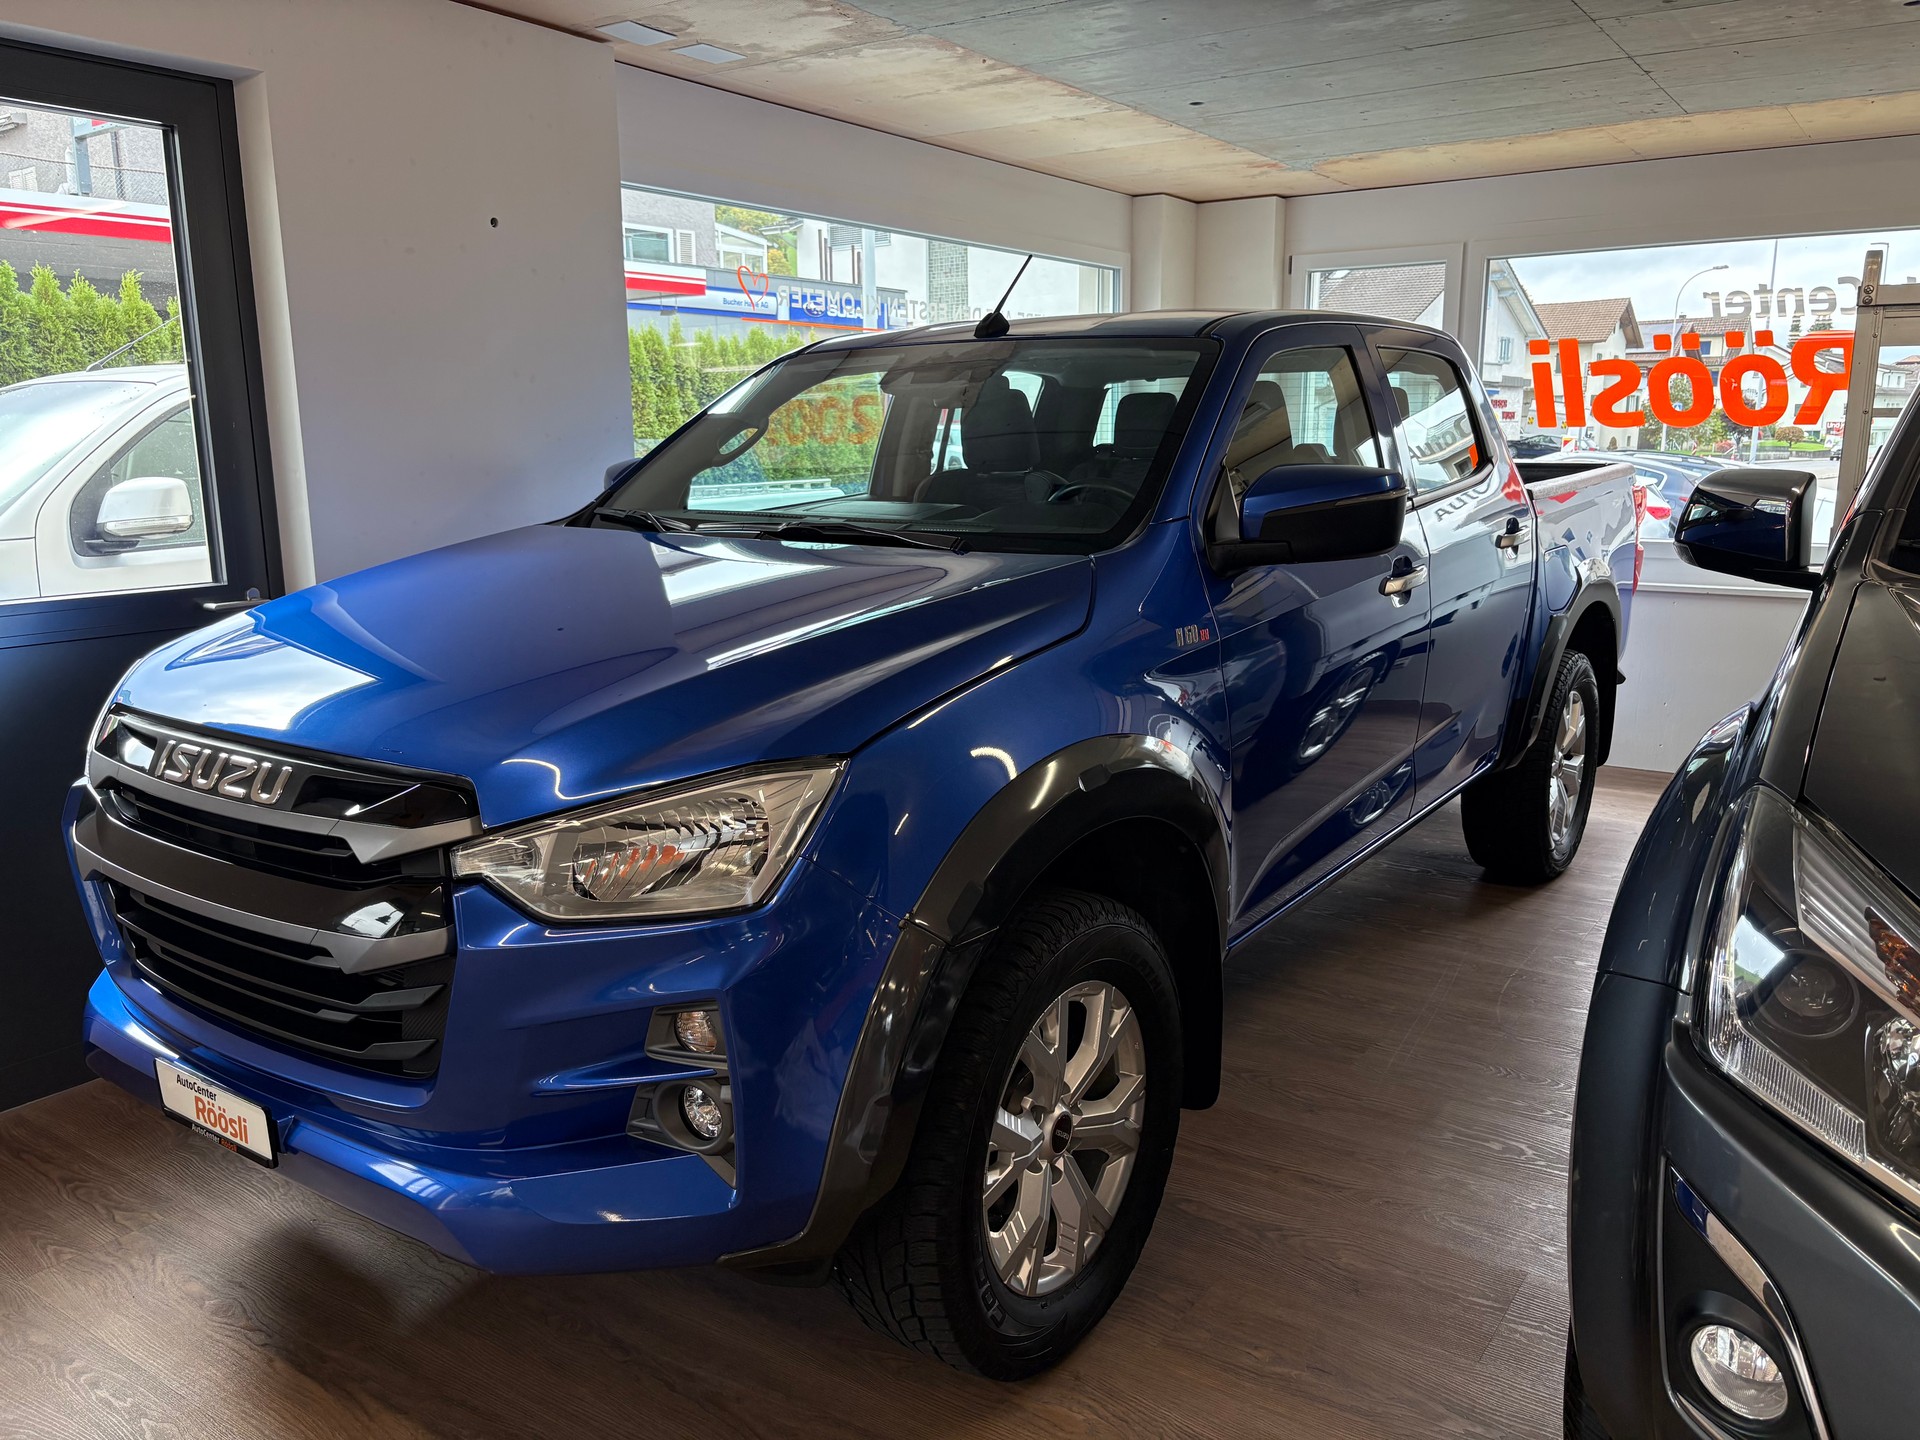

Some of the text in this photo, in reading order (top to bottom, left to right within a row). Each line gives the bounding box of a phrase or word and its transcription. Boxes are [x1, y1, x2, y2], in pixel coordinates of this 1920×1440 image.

[722, 297, 744, 307] Bucher
[154, 738, 293, 806] ISUZU
[176, 1074, 217, 1102] AutoCenter
[191, 1122, 220, 1144] AutoCenter
[194, 1095, 250, 1145] Röösli
